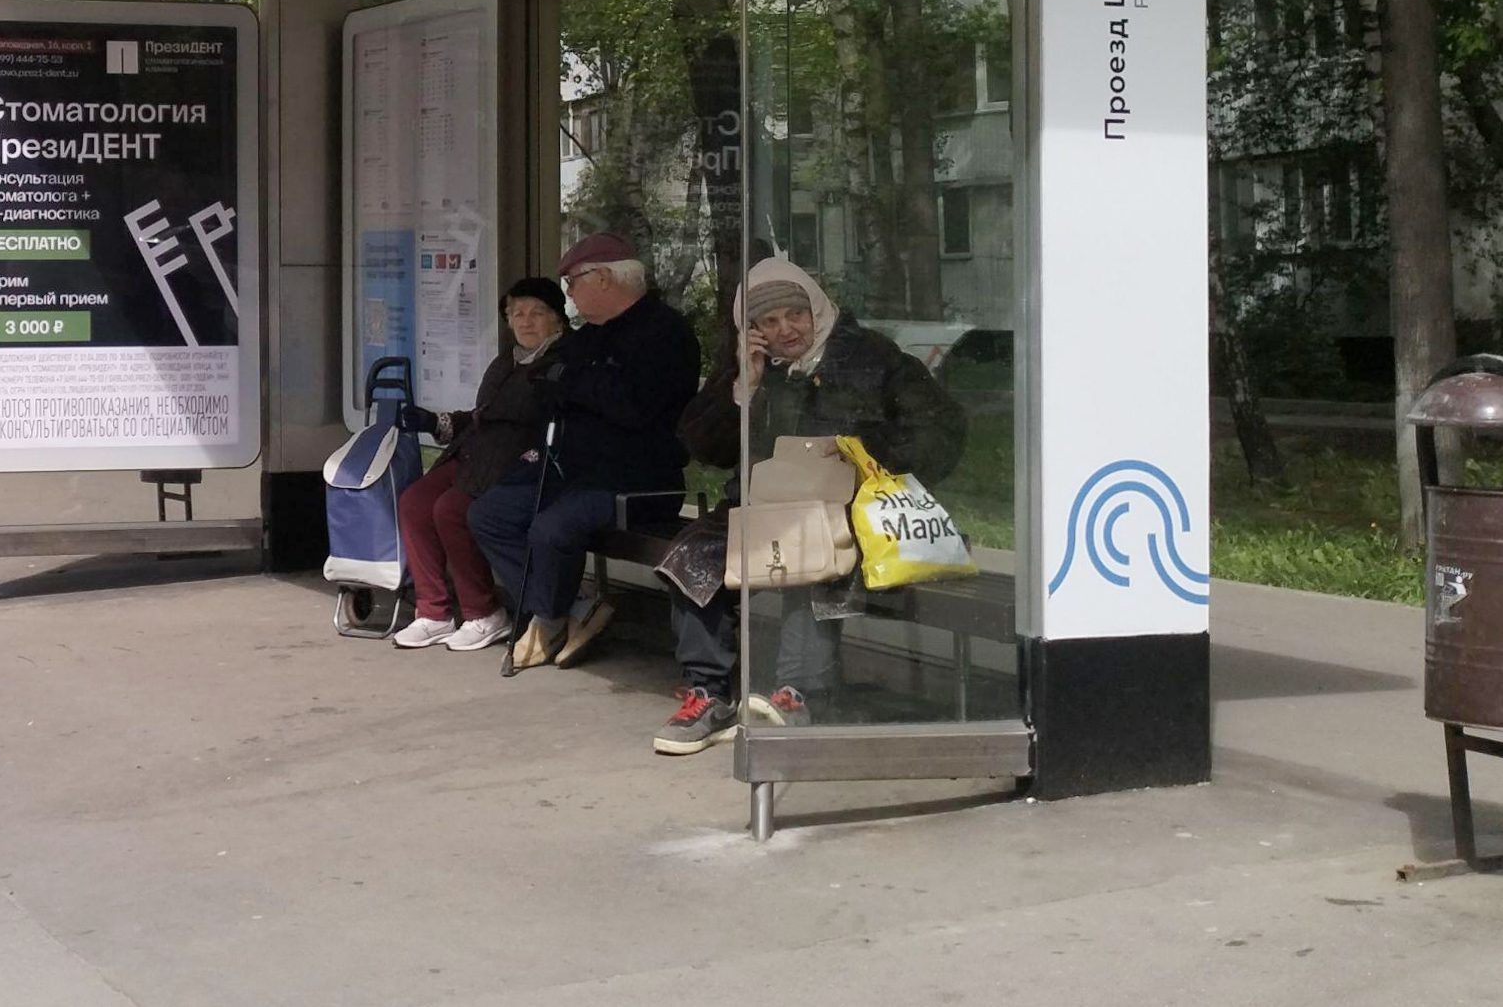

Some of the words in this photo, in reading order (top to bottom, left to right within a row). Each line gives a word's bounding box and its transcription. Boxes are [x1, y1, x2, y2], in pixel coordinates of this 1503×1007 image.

[145, 40, 223, 55] ПрезиДЕНТ
[1104, 19, 1130, 139] Проезд
[60, 294, 109, 308] прием
[5, 320, 16, 334] 3
[19, 320, 49, 334] 000
[34, 396, 153, 418] ПРОТИВОПОКАЗАНИЯ,
[157, 395, 229, 415] НЕОБХОДИМО
[123, 417, 137, 437] СО
[141, 415, 229, 438] СПЕЦИАЛИСТОМ
